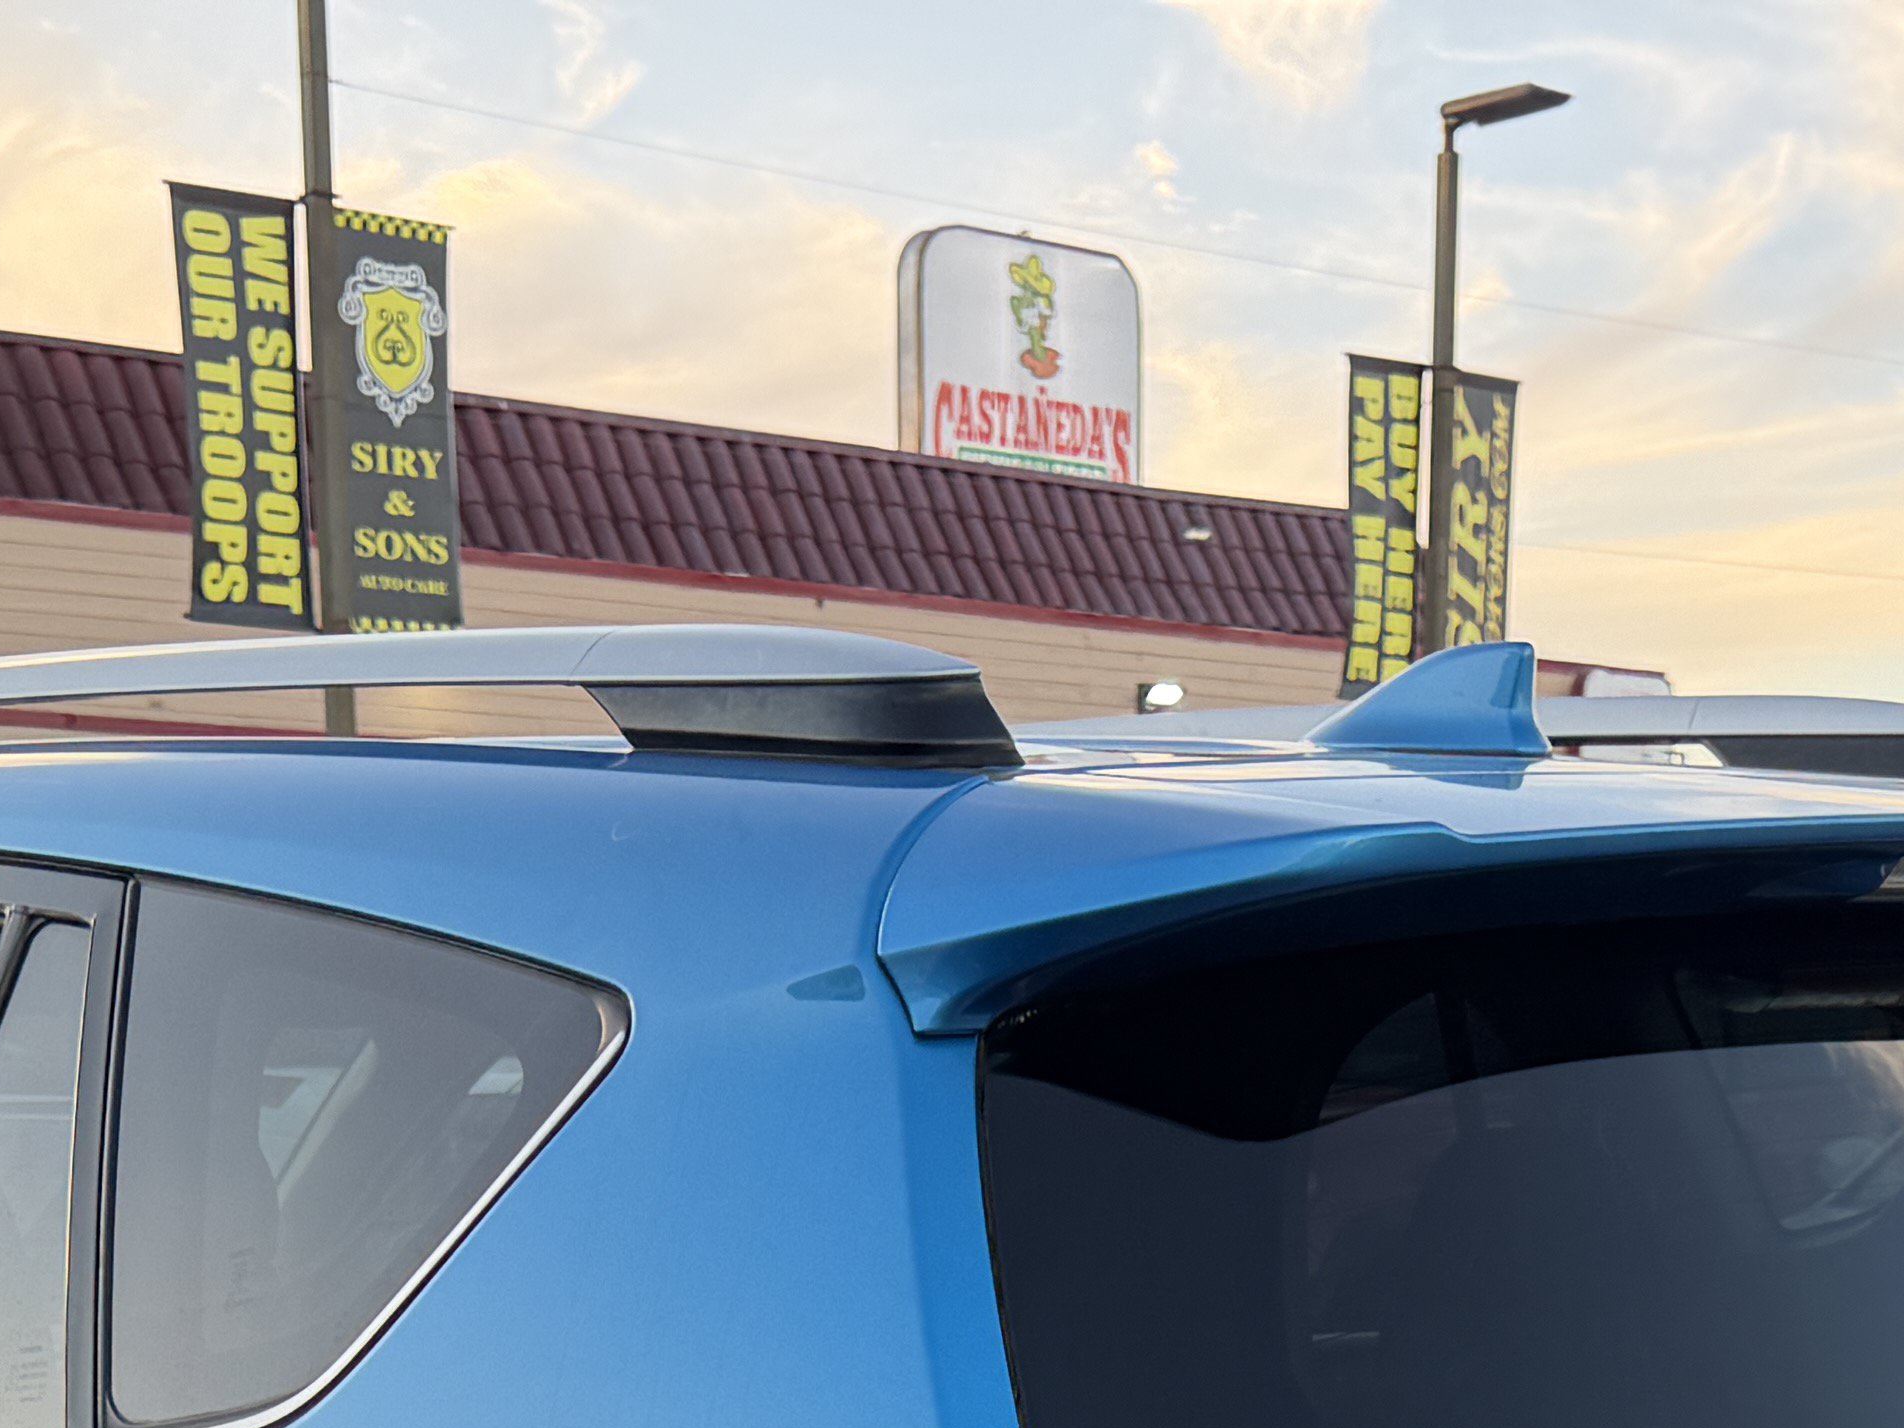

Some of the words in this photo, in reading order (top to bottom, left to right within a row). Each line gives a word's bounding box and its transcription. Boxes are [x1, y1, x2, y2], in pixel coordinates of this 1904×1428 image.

[182, 209, 237, 341] OUR
[239, 214, 291, 316] WE
[195, 355, 249, 604] TROOPS
[247, 326, 304, 616] SUPPORT
[351, 440, 444, 480] SIRY
[1352, 376, 1386, 501] PAY
[1388, 374, 1418, 513] BUY
[354, 527, 450, 565] SONS
[384, 490, 416, 517] &
[1347, 514, 1385, 684] HERE
